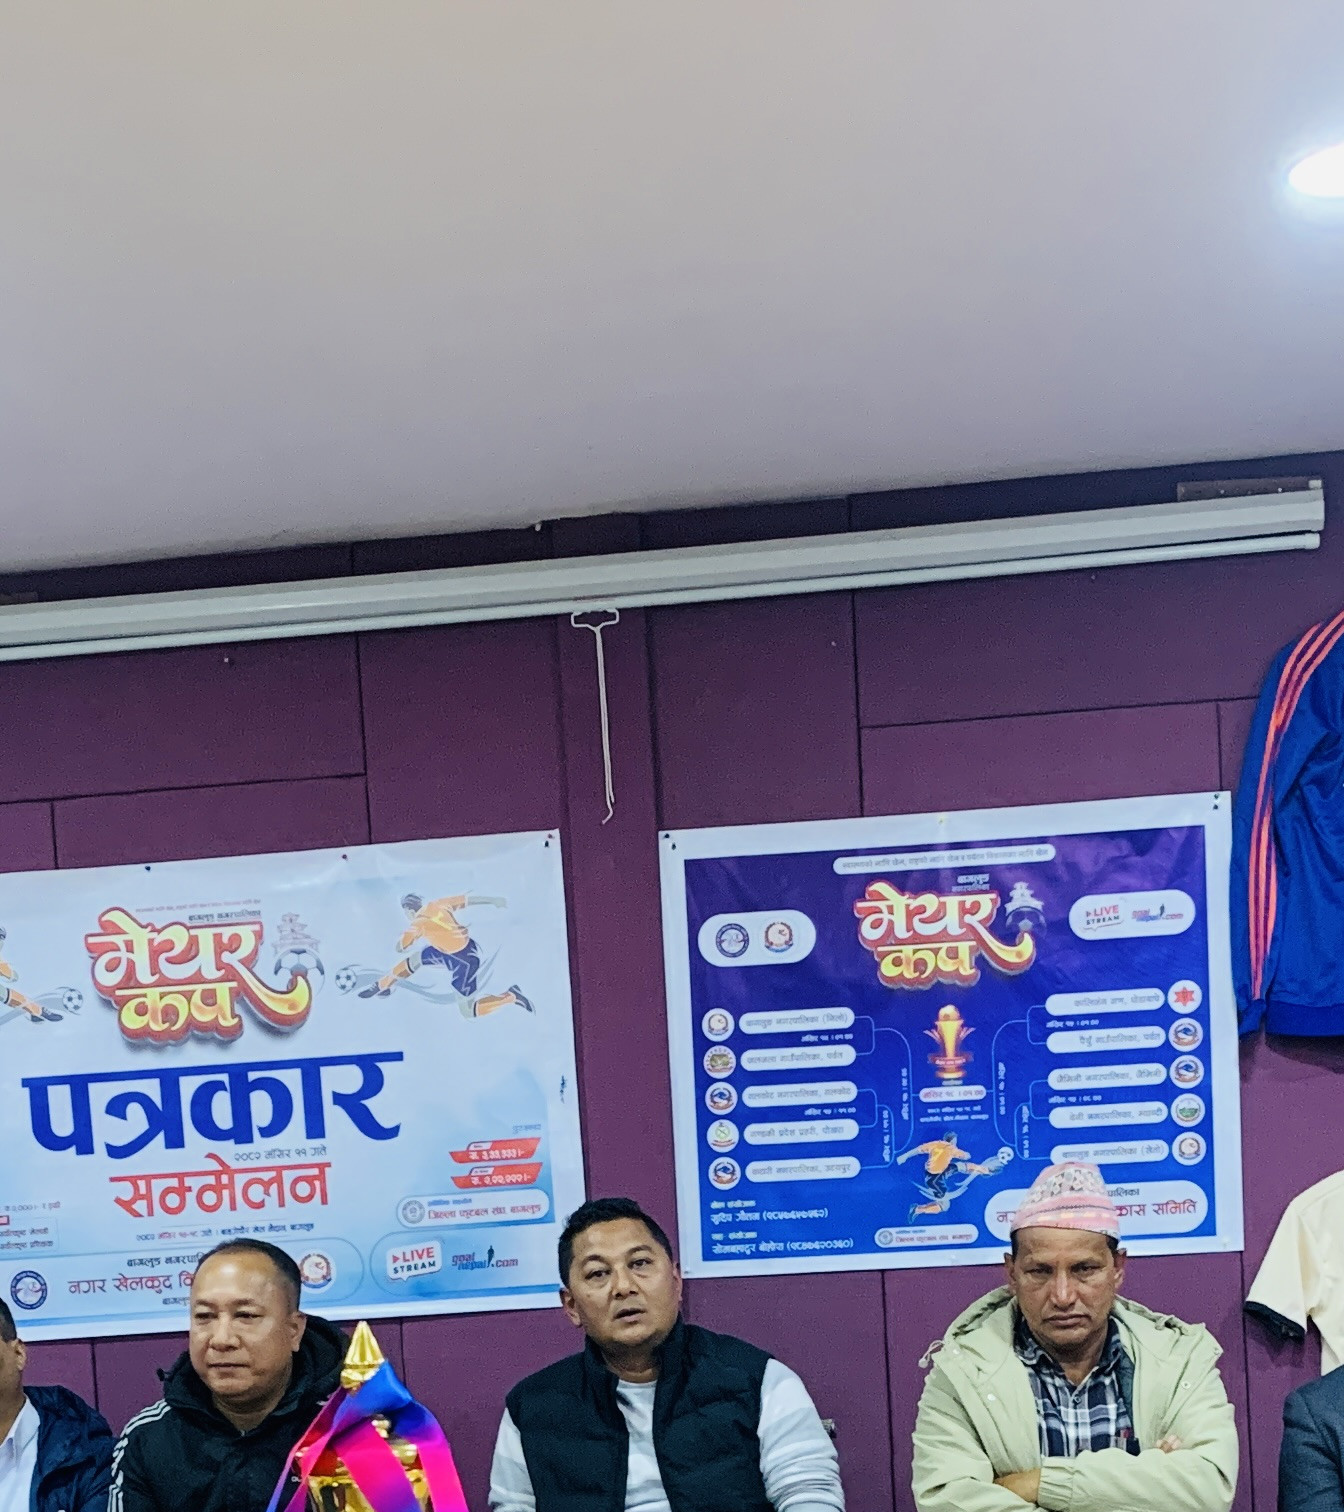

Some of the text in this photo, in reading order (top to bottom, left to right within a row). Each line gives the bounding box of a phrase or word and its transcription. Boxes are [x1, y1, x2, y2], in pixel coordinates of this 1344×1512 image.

[856, 880, 1035, 964] मेयर
[1086, 915, 1120, 925] STREAM
[1093, 904, 1119, 917] LIVE
[87, 909, 310, 1017] मेयर
[877, 941, 977, 978] कप
[114, 980, 239, 1032] कप
[21, 1051, 404, 1160] पत्रकार
[109, 1151, 333, 1218] सम्मेलन
[1152, 1199, 1198, 1216] समिति
[393, 1260, 436, 1274] STREAM
[403, 1246, 435, 1263] LIVE
[67, 1278, 106, 1294] नगर
[113, 1272, 173, 1294] खेलकुद
